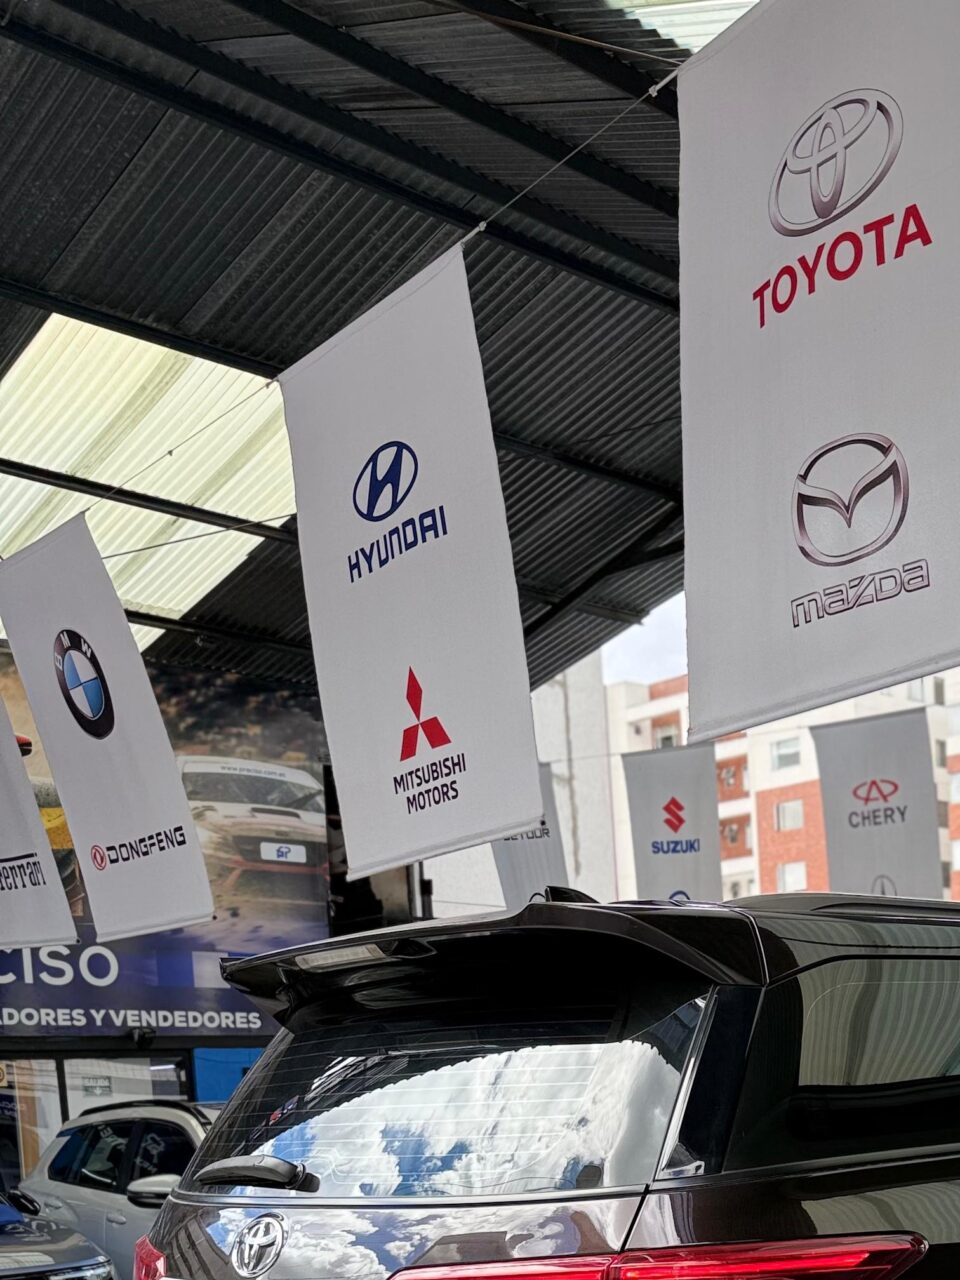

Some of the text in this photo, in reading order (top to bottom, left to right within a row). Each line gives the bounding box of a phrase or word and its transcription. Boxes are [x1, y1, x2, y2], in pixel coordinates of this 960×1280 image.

[752, 204, 933, 328] TOYOTA
[347, 505, 448, 583] HYUNDAI
[393, 753, 467, 795] MITSUBISHI
[406, 781, 459, 815] MOTORS
[848, 805, 908, 829] CHERY
[106, 825, 187, 865] DONGFENG
[652, 838, 700, 855] SUZUKI
[0, 1008, 262, 1029] DORES Y VENDEDORES
